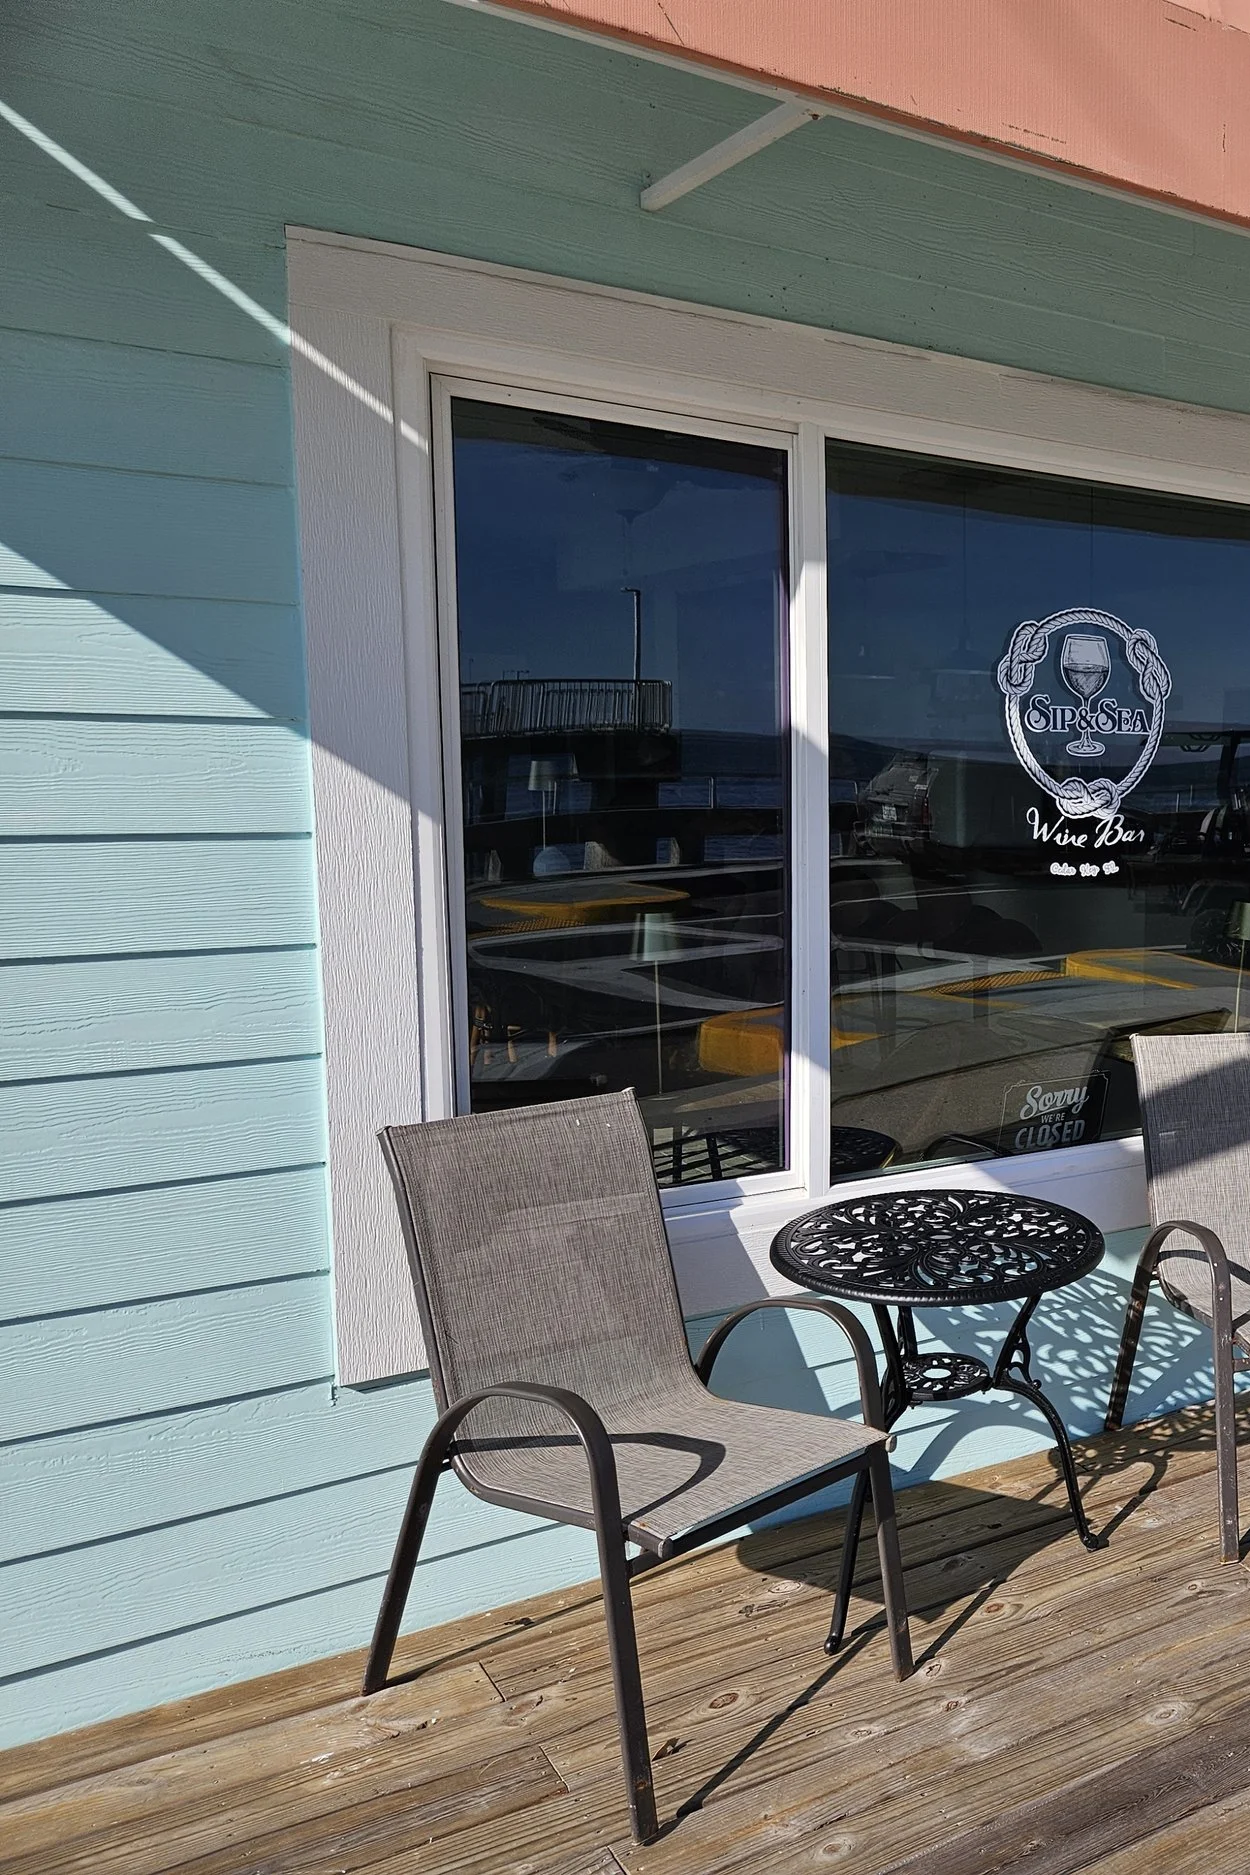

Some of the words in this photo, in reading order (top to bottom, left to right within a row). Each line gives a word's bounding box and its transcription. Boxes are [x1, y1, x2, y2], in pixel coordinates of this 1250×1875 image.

[1027, 807, 1088, 848] Wine
[1094, 814, 1145, 849] Bar
[1020, 1085, 1089, 1120] Sorry
[1041, 1112, 1066, 1123] WE'RE
[1015, 1119, 1086, 1149] CLOSED
